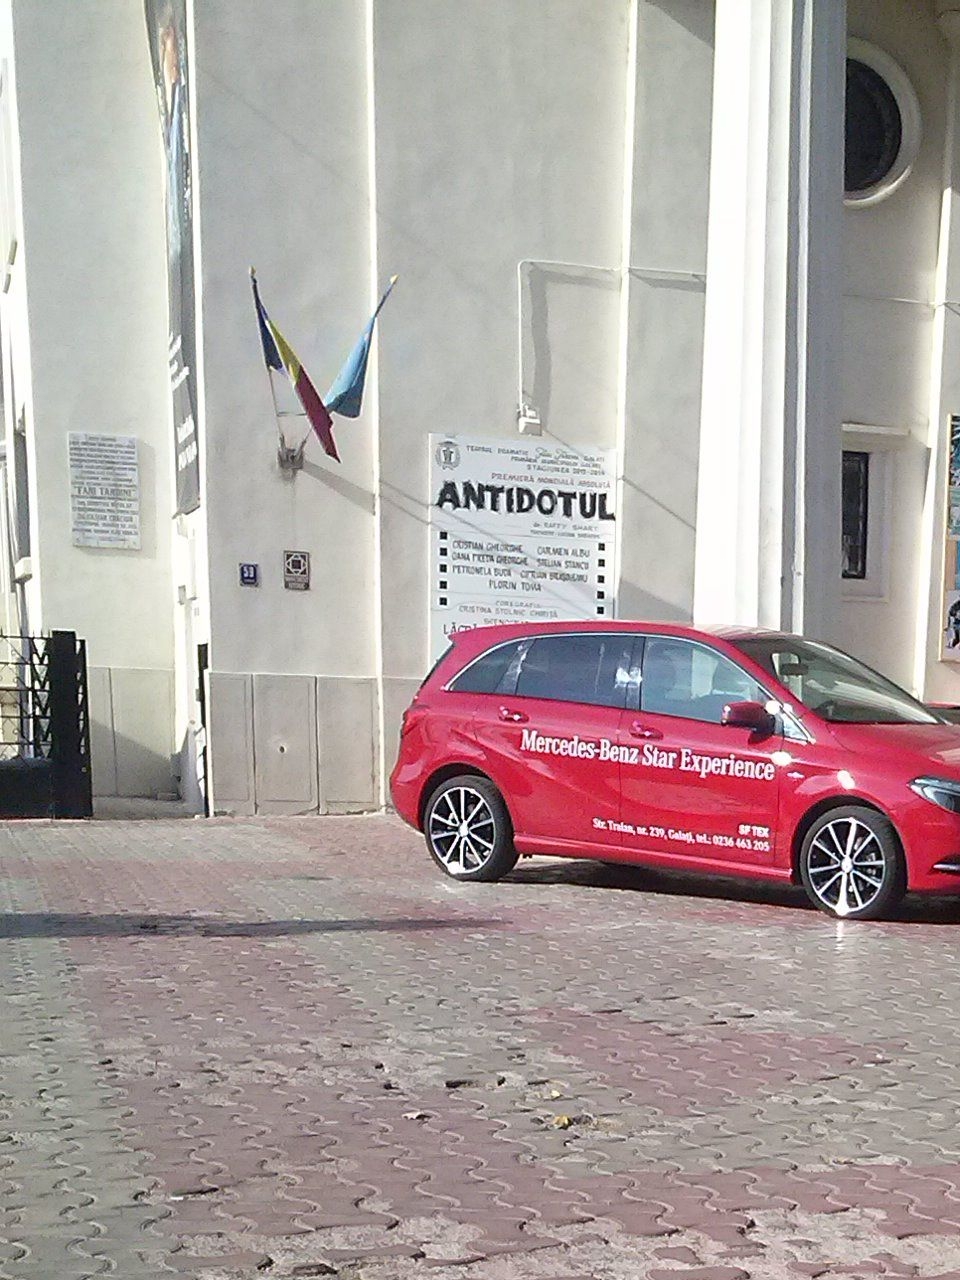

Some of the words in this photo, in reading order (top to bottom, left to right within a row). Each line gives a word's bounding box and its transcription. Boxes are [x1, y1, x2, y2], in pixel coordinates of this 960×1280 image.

[435, 480, 616, 521] ANTIDOTUL
[520, 729, 639, 765] Mercedes-Benz
[641, 744, 677, 769] Star
[679, 748, 775, 781] Experience
[712, 835, 734, 847] 0236
[736, 838, 752, 850] 463
[739, 824, 751, 835] SF
[752, 826, 769, 838] TEX
